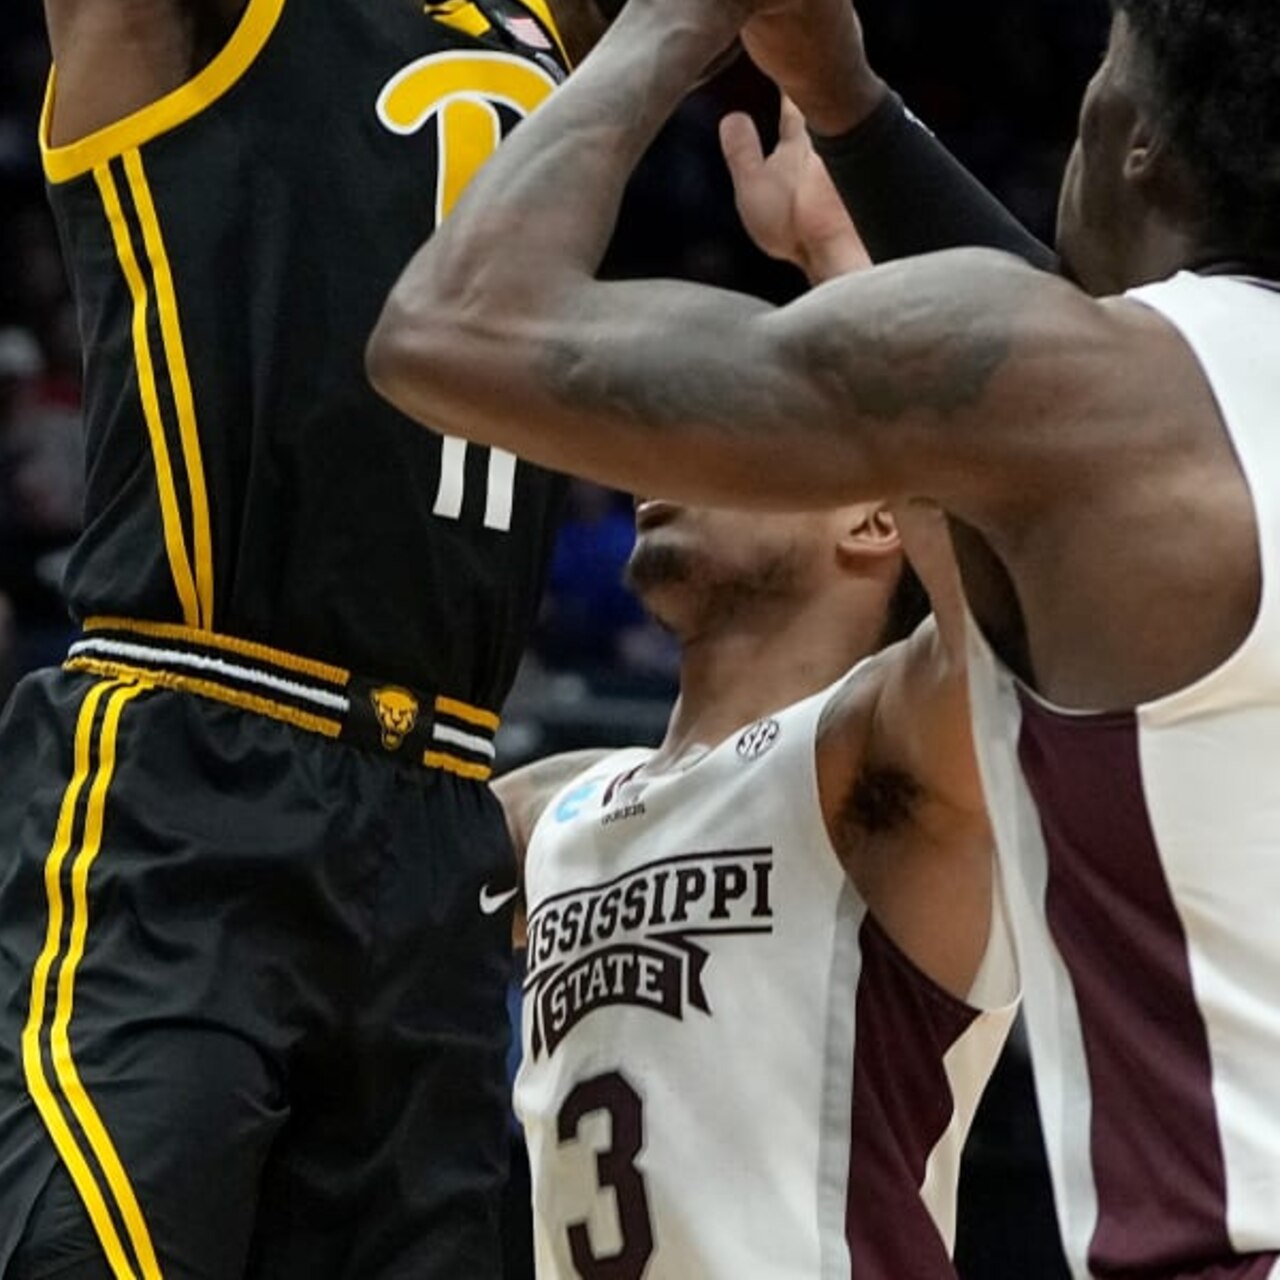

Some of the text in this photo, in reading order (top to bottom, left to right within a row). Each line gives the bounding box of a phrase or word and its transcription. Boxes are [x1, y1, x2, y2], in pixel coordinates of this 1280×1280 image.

[529, 862, 773, 970] ISSISSIPPI
[549, 952, 665, 1032] STATE
[557, 1072, 654, 1280] 3
